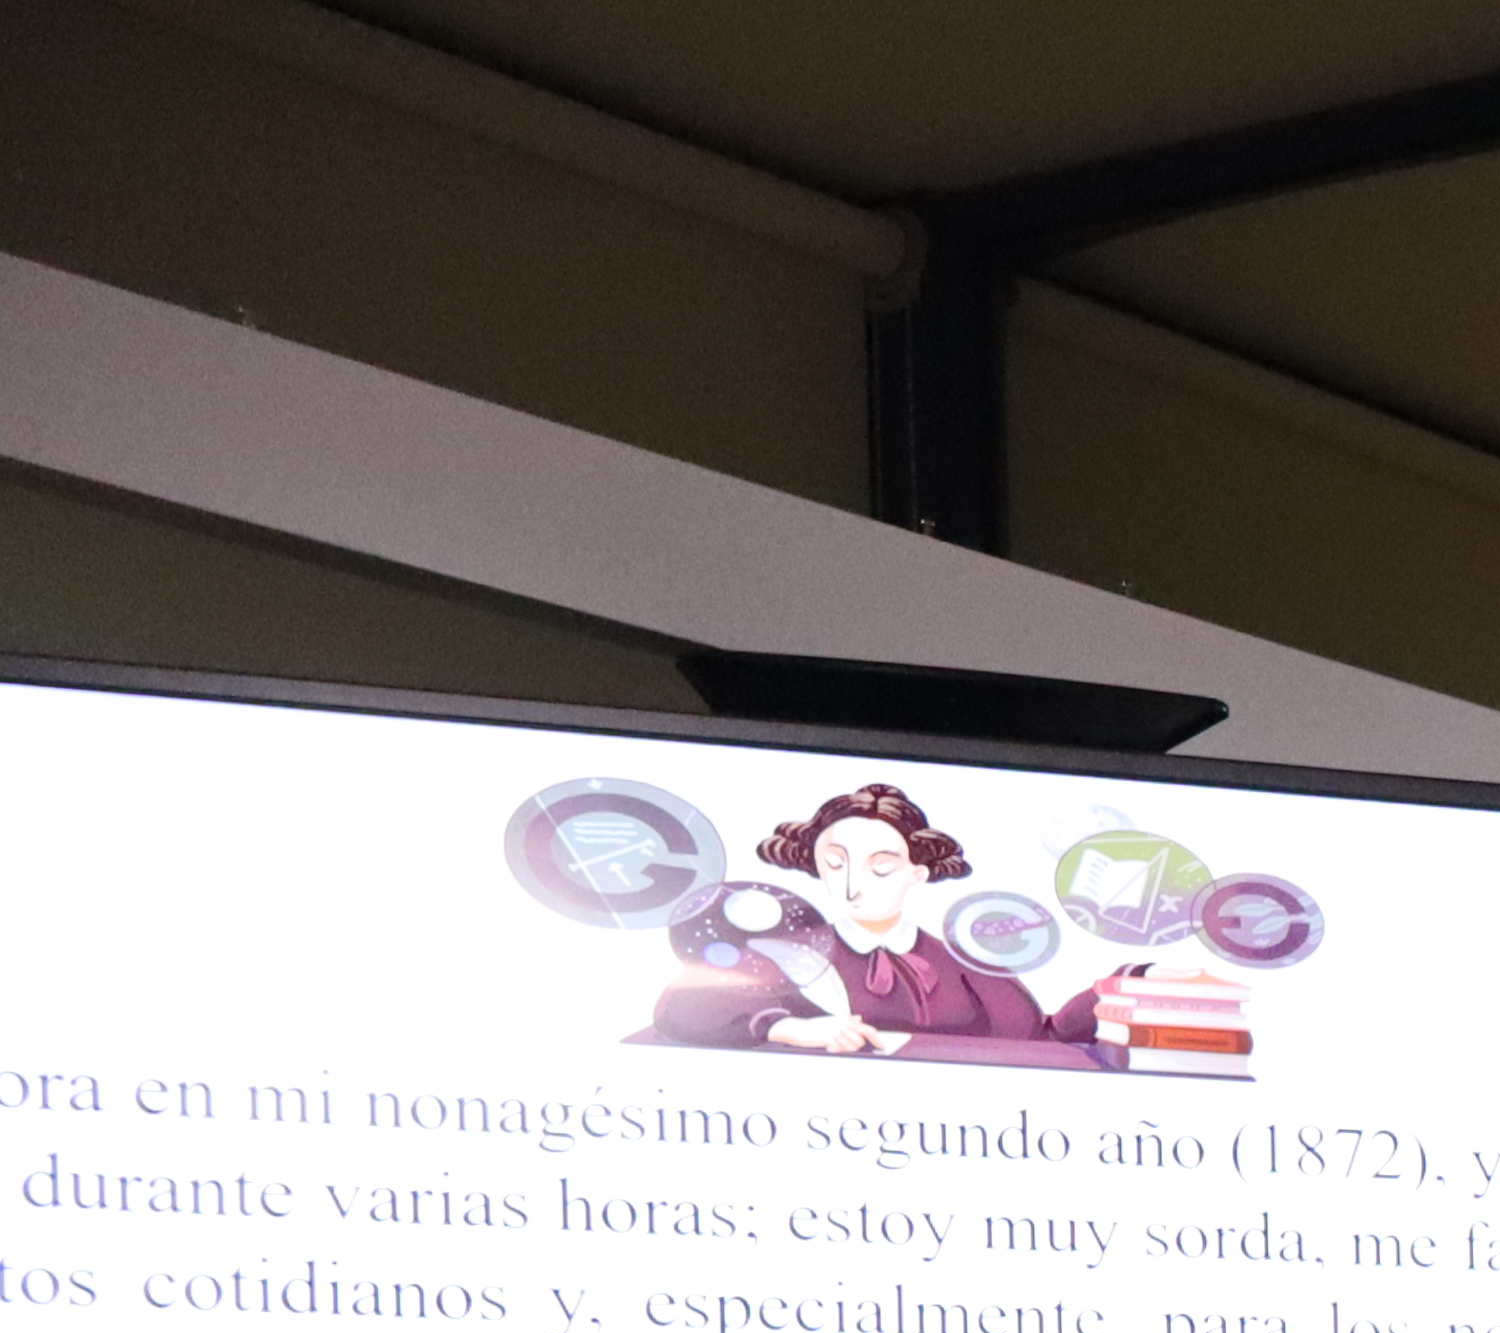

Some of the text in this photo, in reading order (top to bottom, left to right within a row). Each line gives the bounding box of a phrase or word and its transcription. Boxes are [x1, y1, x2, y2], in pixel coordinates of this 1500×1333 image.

[135, 1079, 215, 1119] en
[248, 1070, 332, 1125] mi
[367, 1086, 778, 1153] nonagésimo
[807, 1109, 1071, 1170] segundo
[1098, 1120, 1205, 1169] año
[1231, 1124, 1446, 1189] (1872),
[21, 1152, 293, 1218] durante
[325, 1171, 529, 1228] varias
[559, 1177, 758, 1243] horas;
[788, 1202, 955, 1263] estoy
[984, 1216, 1118, 1270] muy
[1145, 1211, 1324, 1267] sorda,
[1353, 1233, 1437, 1269] me
[143, 1257, 507, 1321] cotidianos
